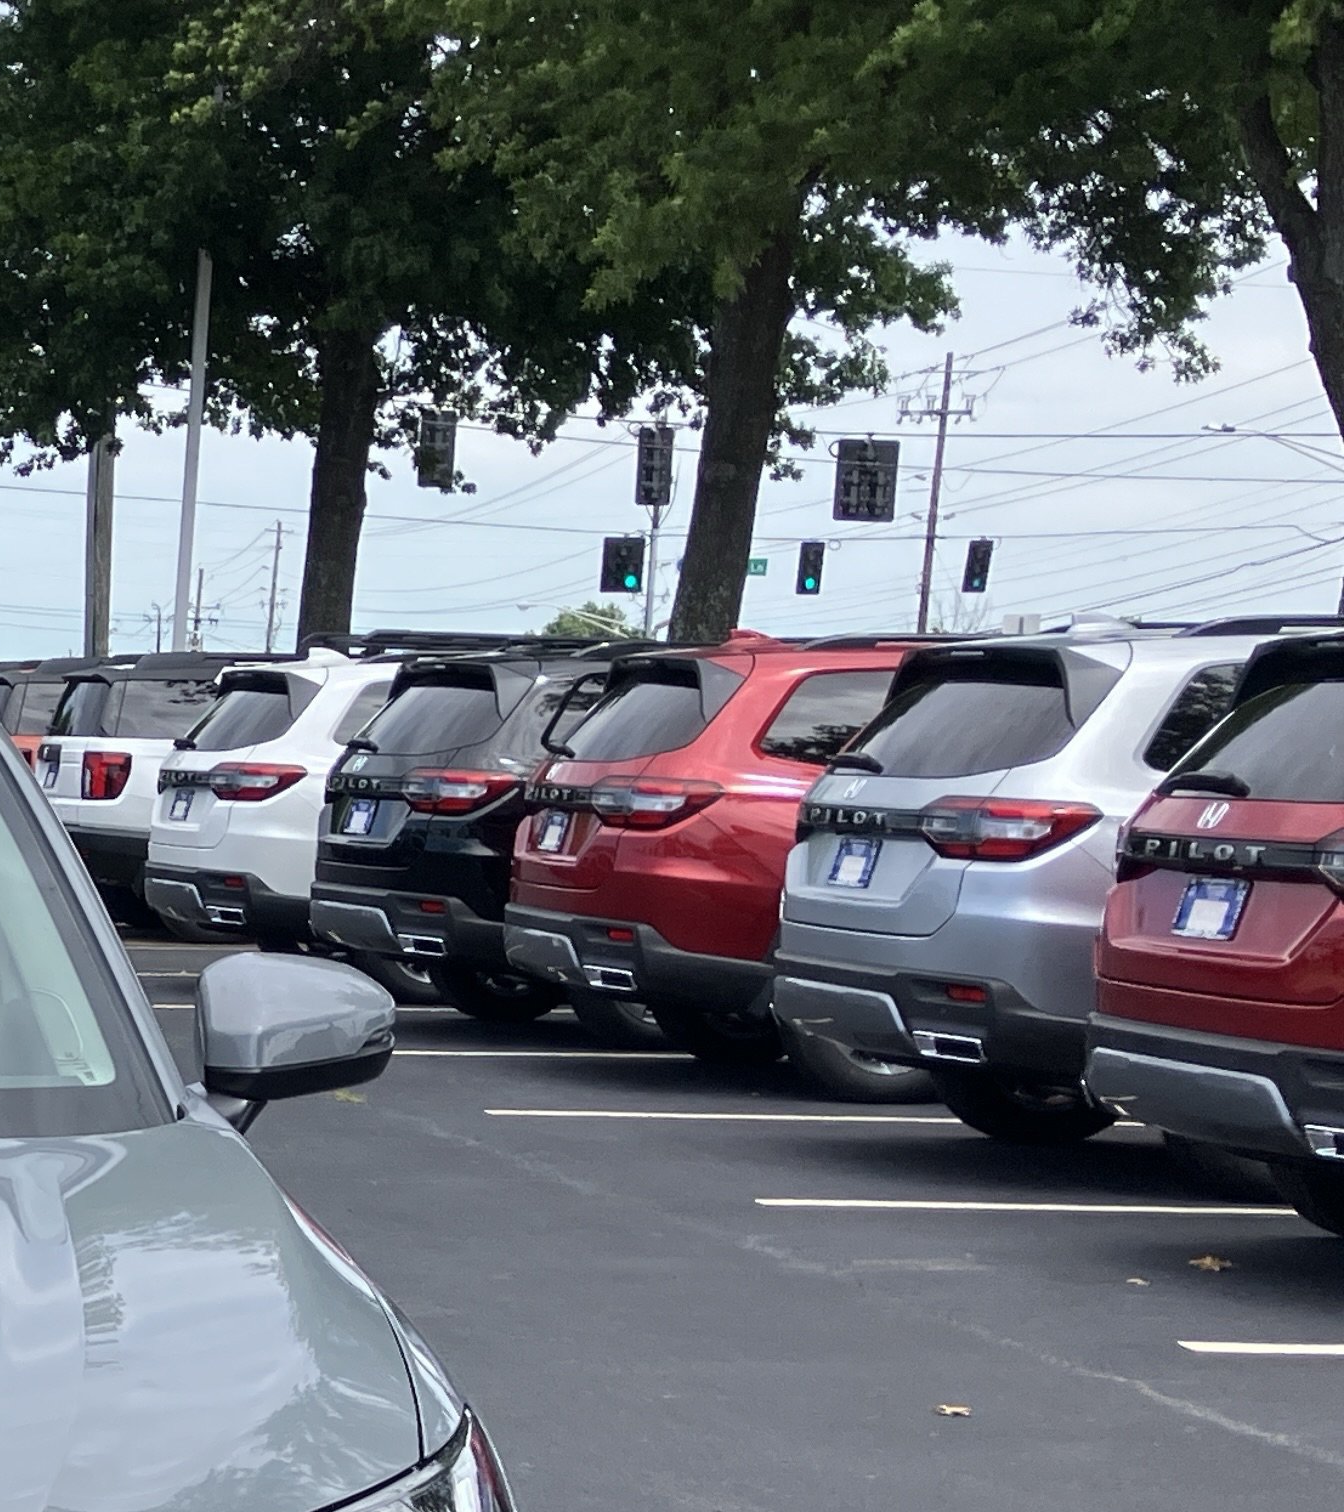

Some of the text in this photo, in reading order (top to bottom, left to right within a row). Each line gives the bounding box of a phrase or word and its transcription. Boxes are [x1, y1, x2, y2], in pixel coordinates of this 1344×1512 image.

[331, 776, 381, 790] PILOT
[810, 807, 888, 826] PILOT
[1144, 839, 1267, 863] PILOT
